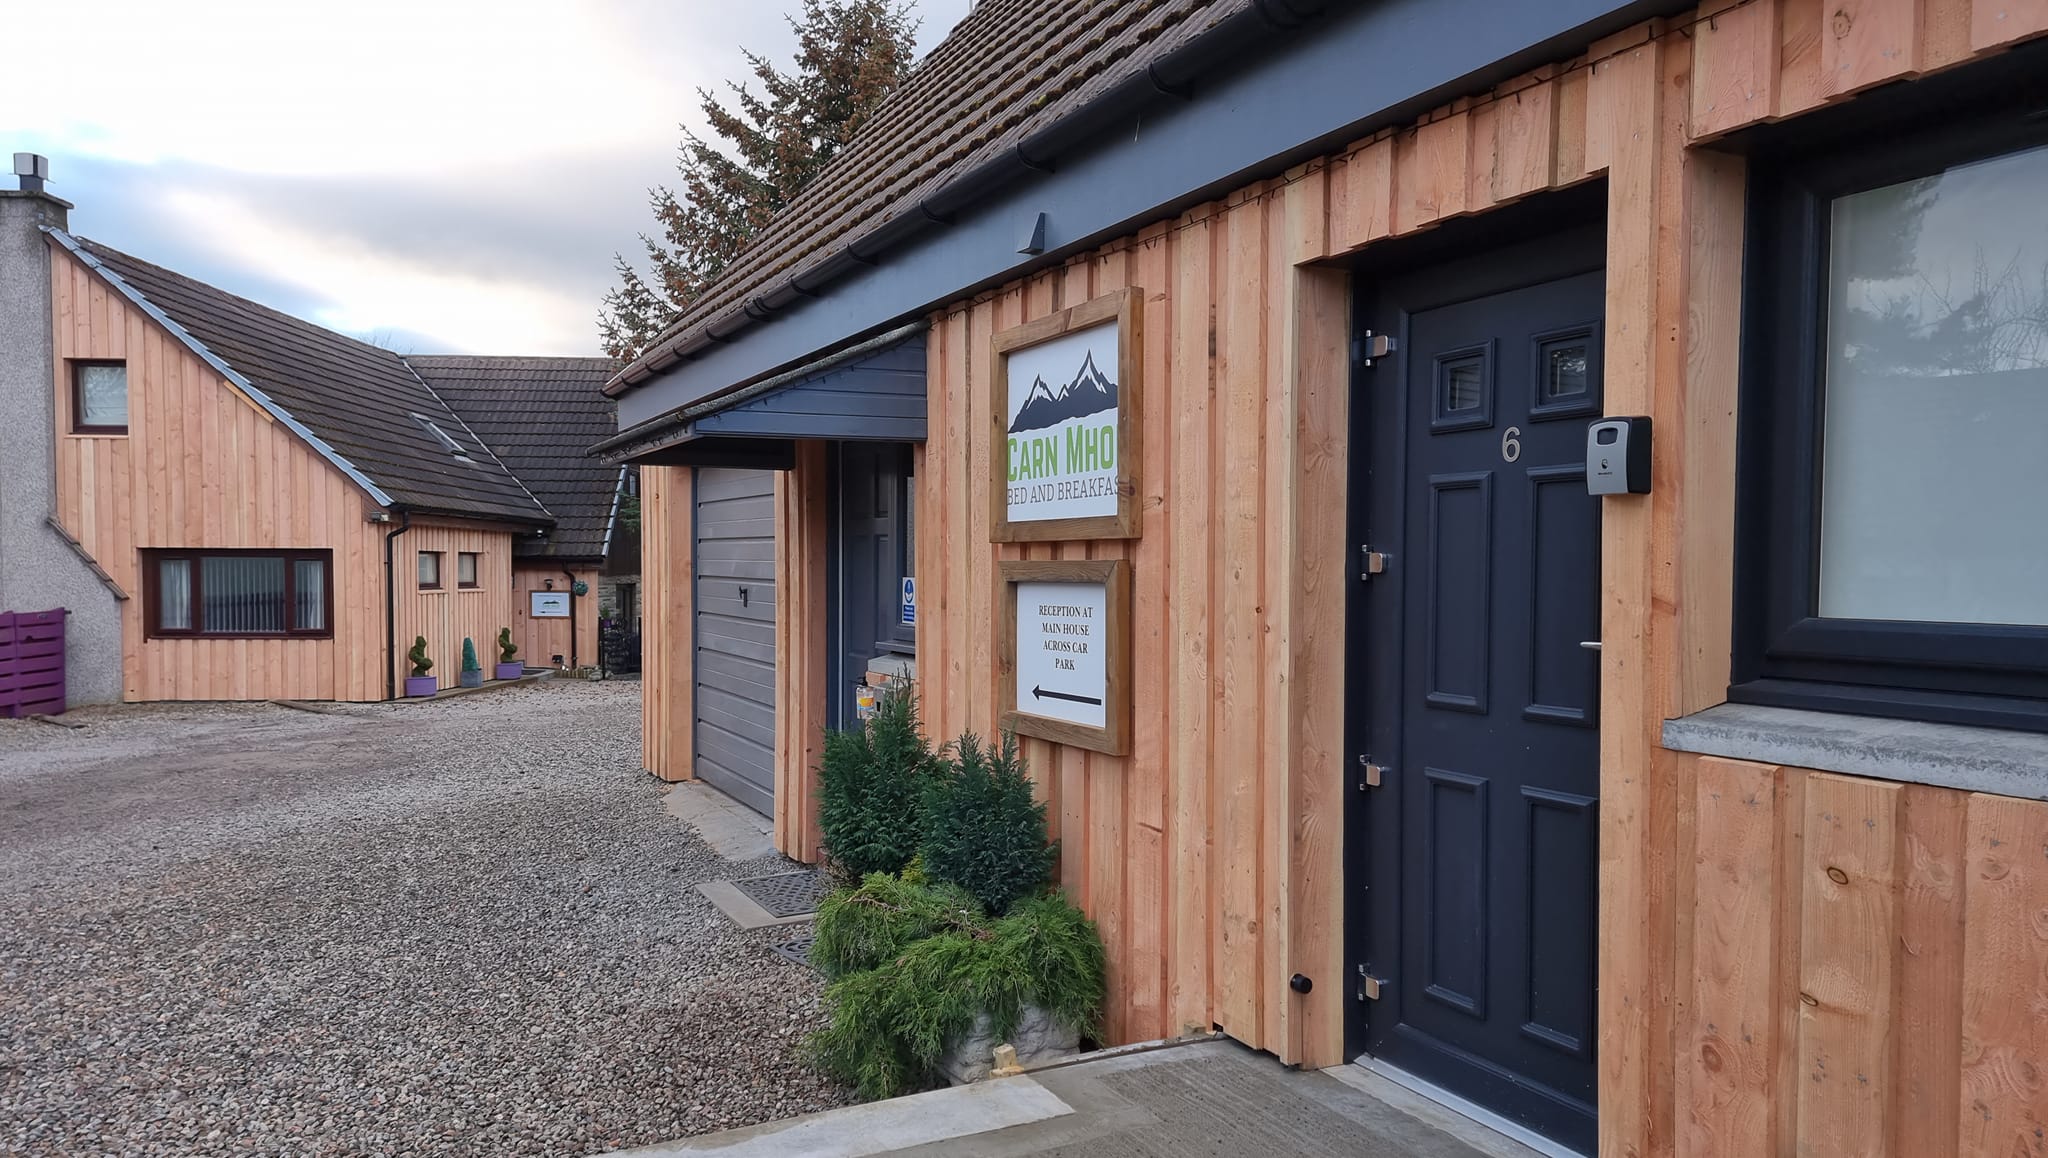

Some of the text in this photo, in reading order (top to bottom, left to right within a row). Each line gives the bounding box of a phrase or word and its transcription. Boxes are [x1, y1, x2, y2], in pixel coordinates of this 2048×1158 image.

[1502, 426, 1521, 463] 6
[1008, 424, 1117, 482] CARN MHO
[1007, 486, 1028, 506] BED
[1030, 483, 1055, 504] AND
[1039, 604, 1094, 618] RECEPTION AT
[1041, 622, 1090, 636] MAIN HOUSE
[1043, 639, 1088, 654] ACROSS CAR
[1055, 657, 1075, 671] PARK
